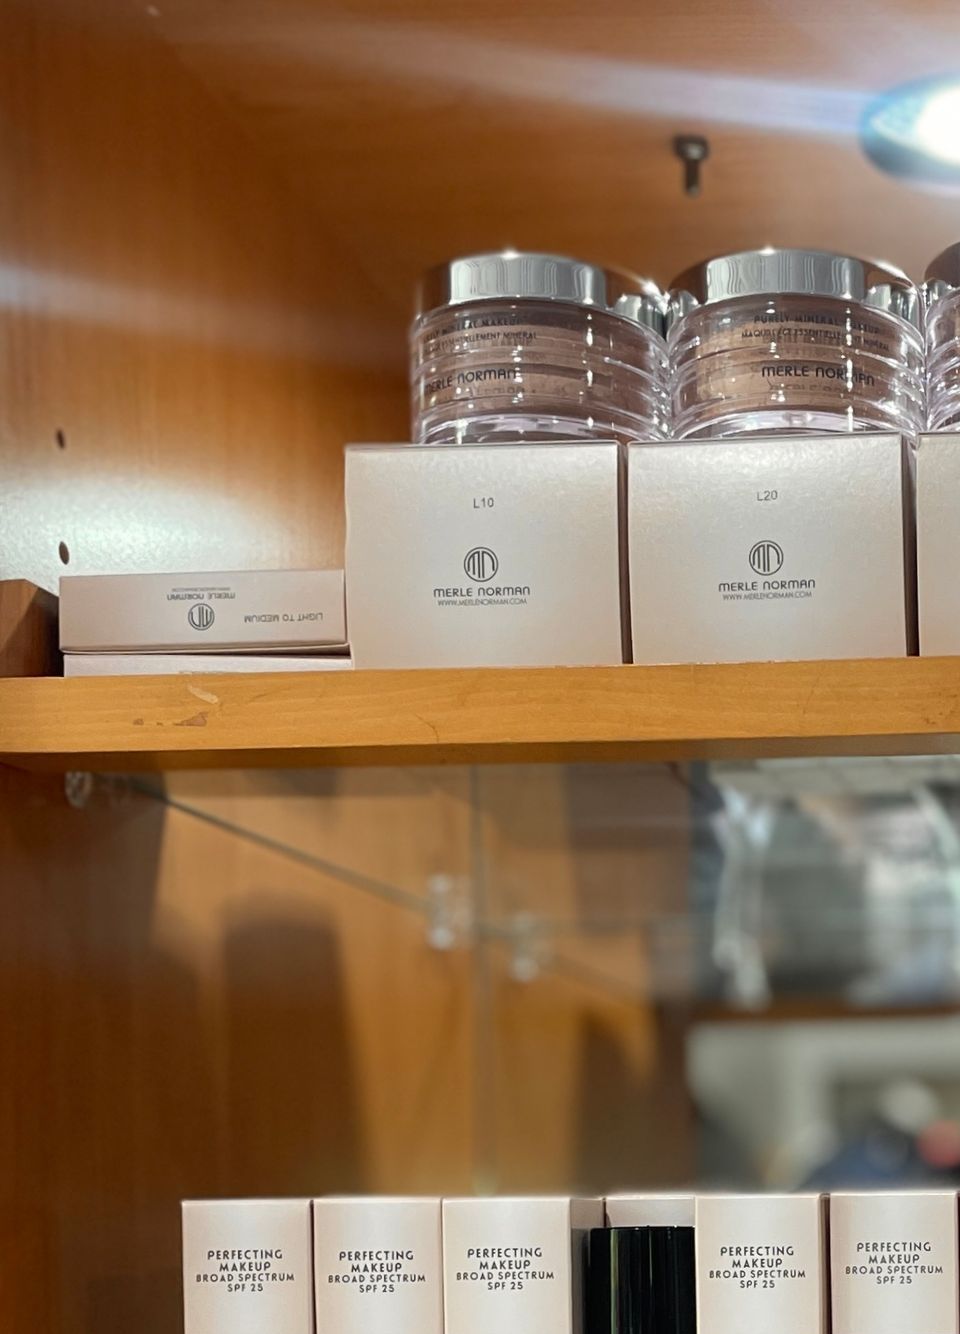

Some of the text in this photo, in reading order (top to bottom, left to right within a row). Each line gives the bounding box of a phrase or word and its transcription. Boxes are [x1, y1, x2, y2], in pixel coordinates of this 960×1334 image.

[457, 369, 517, 384] NORMAN
[762, 366, 809, 377] MERLE
[756, 490, 778, 502] L20
[473, 497, 494, 509] L10
[718, 579, 816, 593] MERLE NORMAN
[433, 586, 530, 599] MERLE NORMAN
[207, 1249, 282, 1260] PERFECTING
[720, 1246, 794, 1256] PERFECTING
[219, 1261, 271, 1272] MAKEUP
[732, 1258, 782, 1268] MAKEUP
[196, 1273, 294, 1284] BROAD SPECTRUM
[709, 1270, 806, 1279] BROAD SPECTRUM
[227, 1283, 263, 1292] SPF 25
